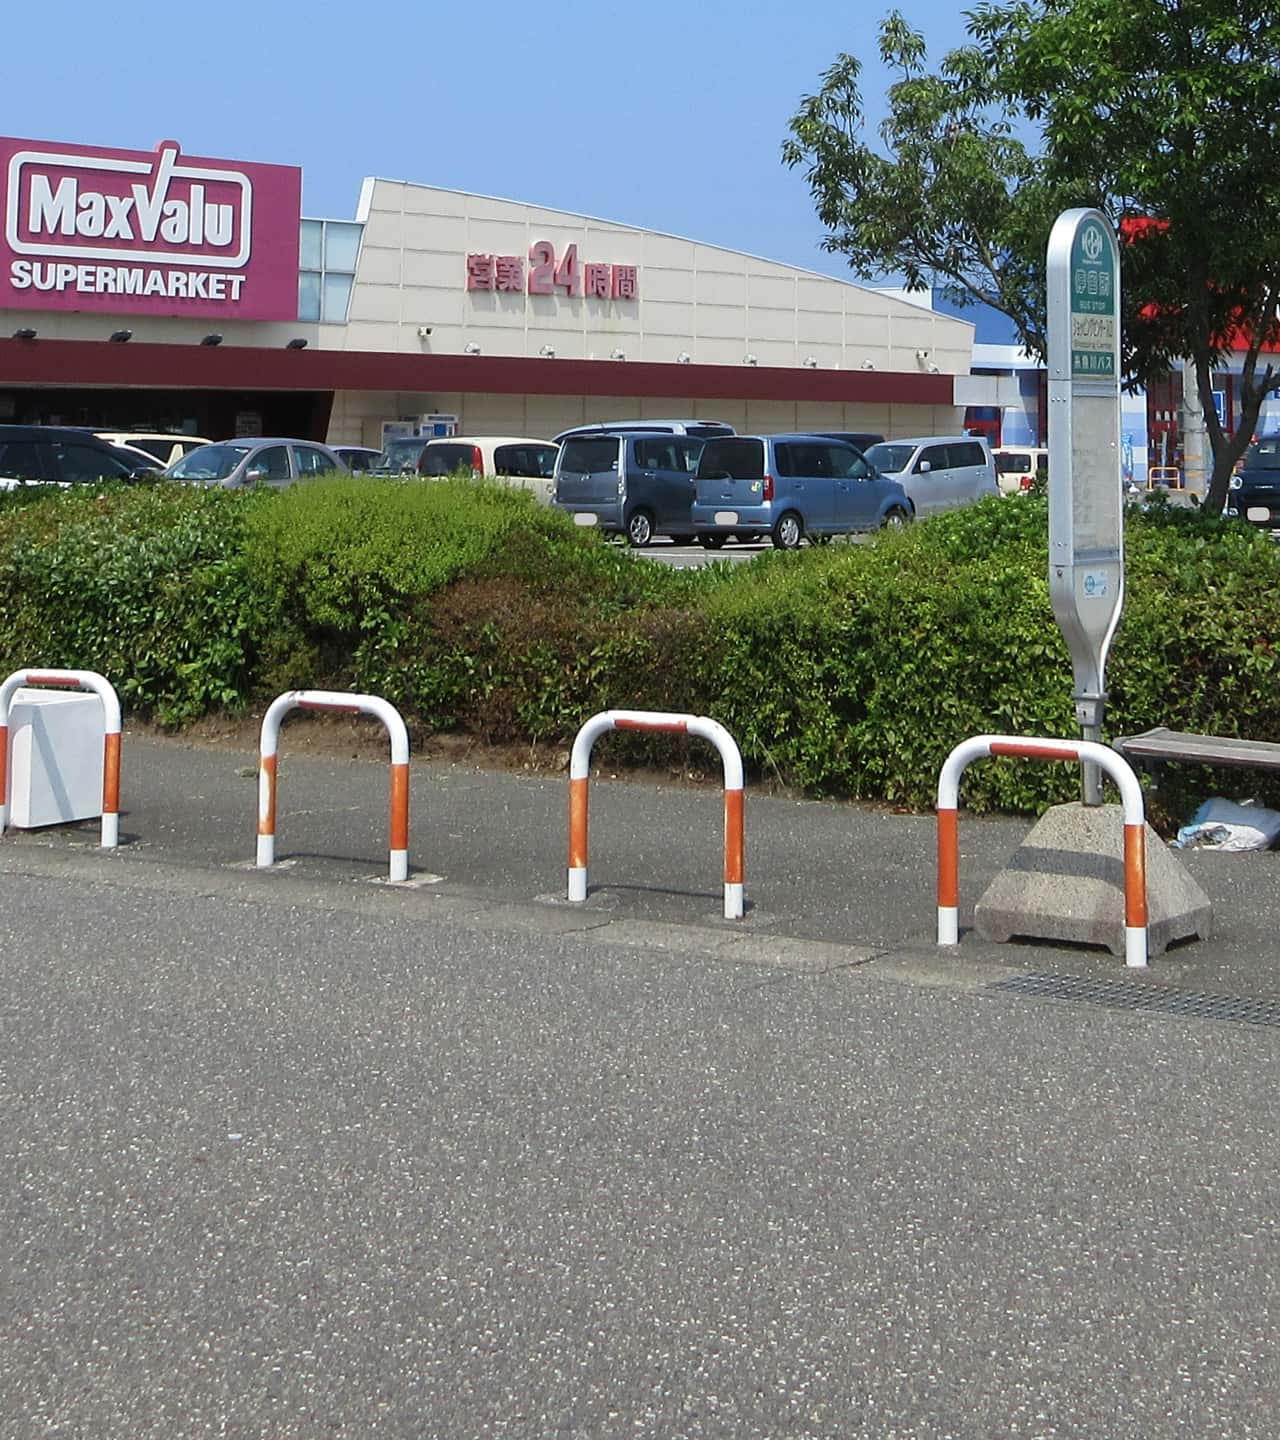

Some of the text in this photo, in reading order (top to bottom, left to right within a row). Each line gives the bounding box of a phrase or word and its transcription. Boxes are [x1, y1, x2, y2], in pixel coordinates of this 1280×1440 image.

[28, 149, 234, 247] MaxValu
[10, 260, 247, 301] SUPERMARKET
[1074, 269, 1111, 297] 停留所
